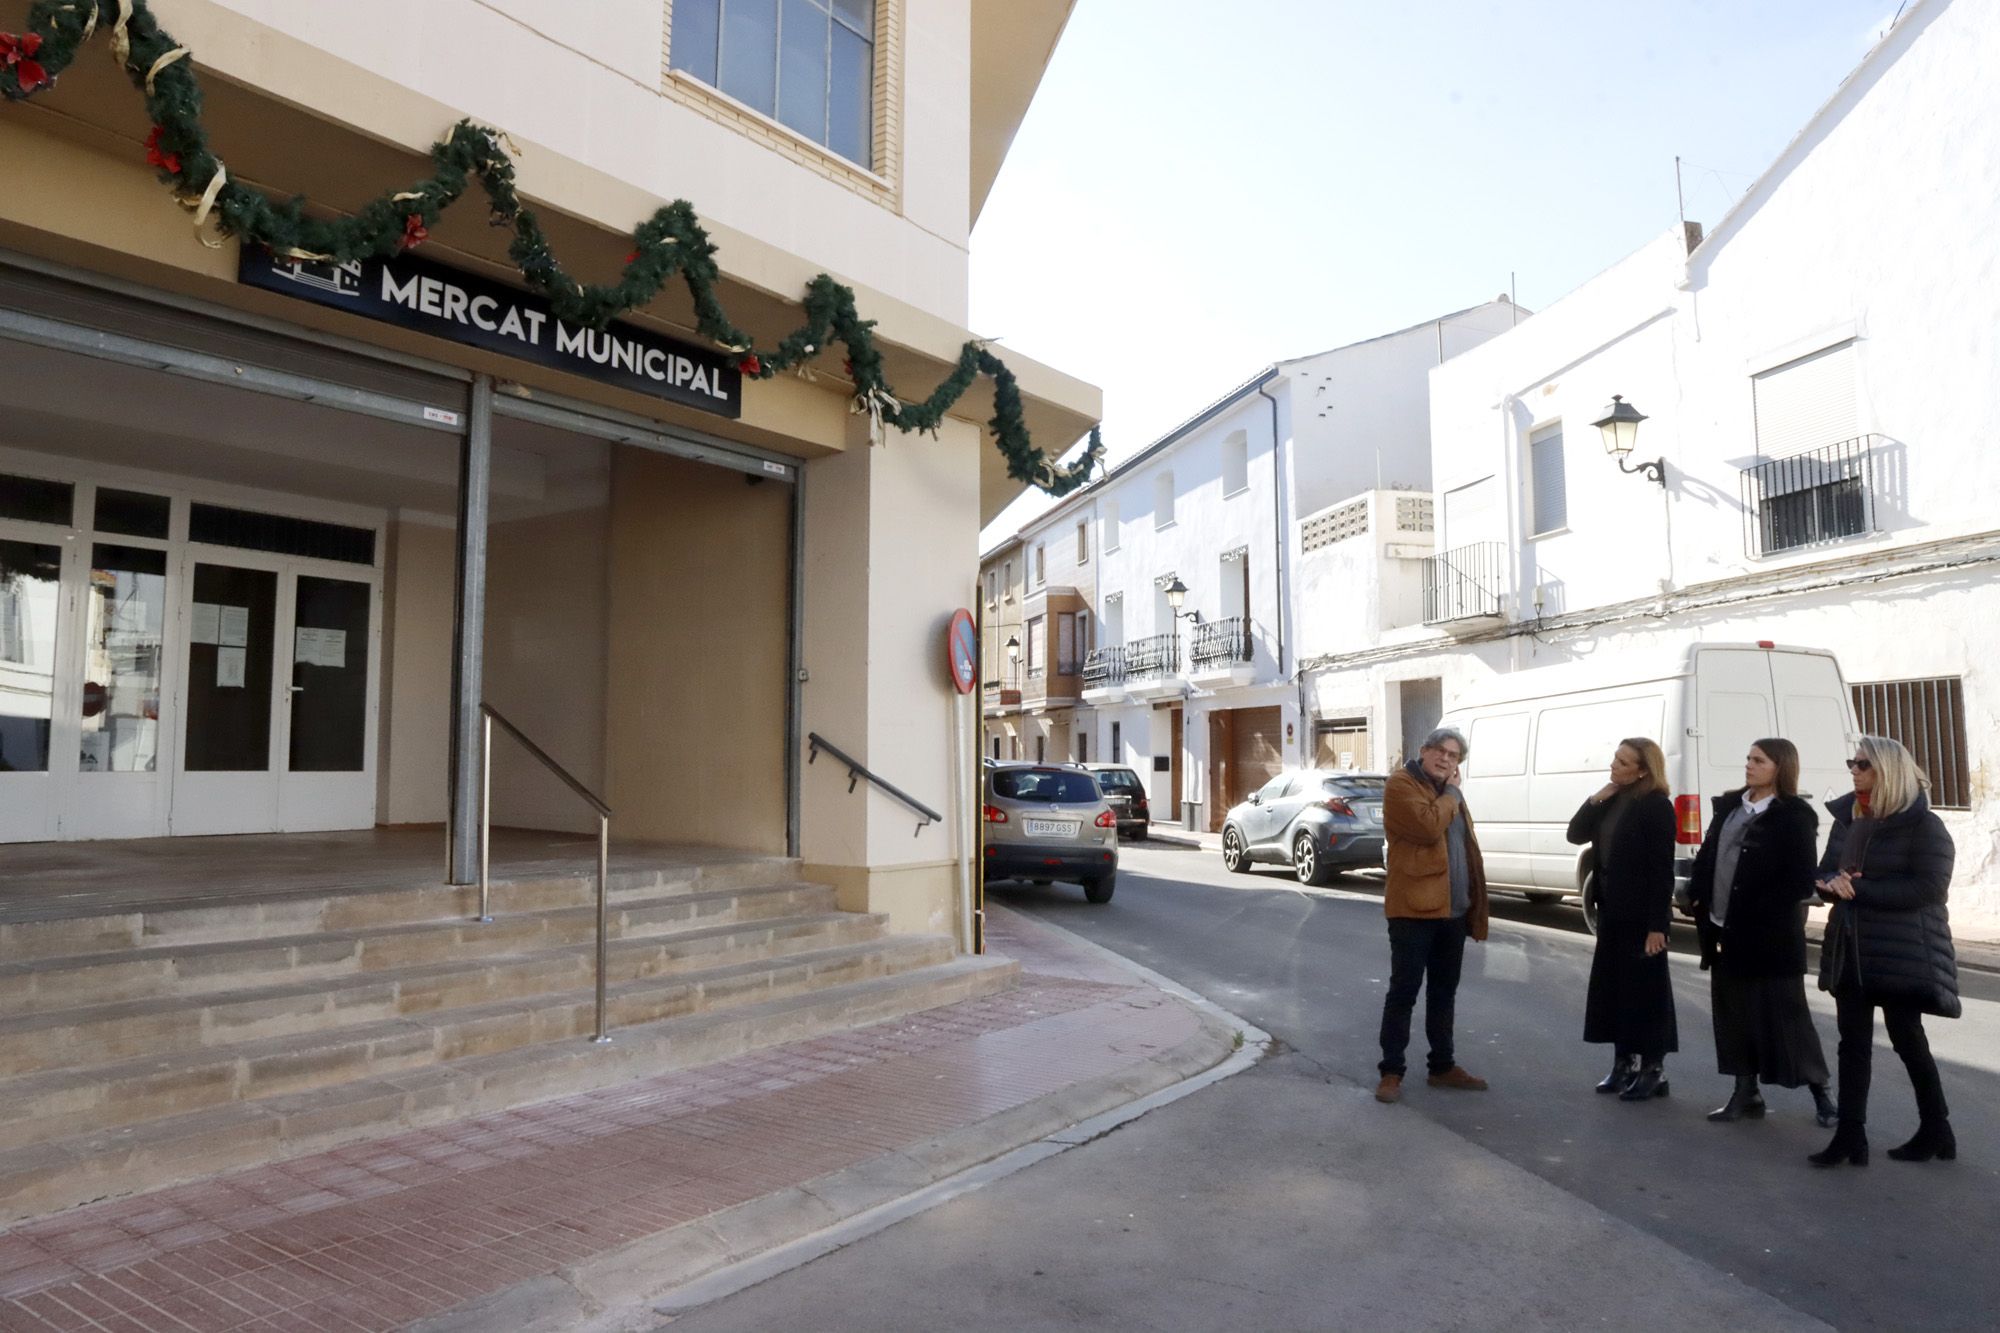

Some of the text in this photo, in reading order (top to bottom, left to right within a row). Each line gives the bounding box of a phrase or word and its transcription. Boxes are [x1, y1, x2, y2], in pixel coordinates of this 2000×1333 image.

[381, 264, 728, 401] MERCAT MUNICIPAL
[1034, 822, 1055, 832] 8897
